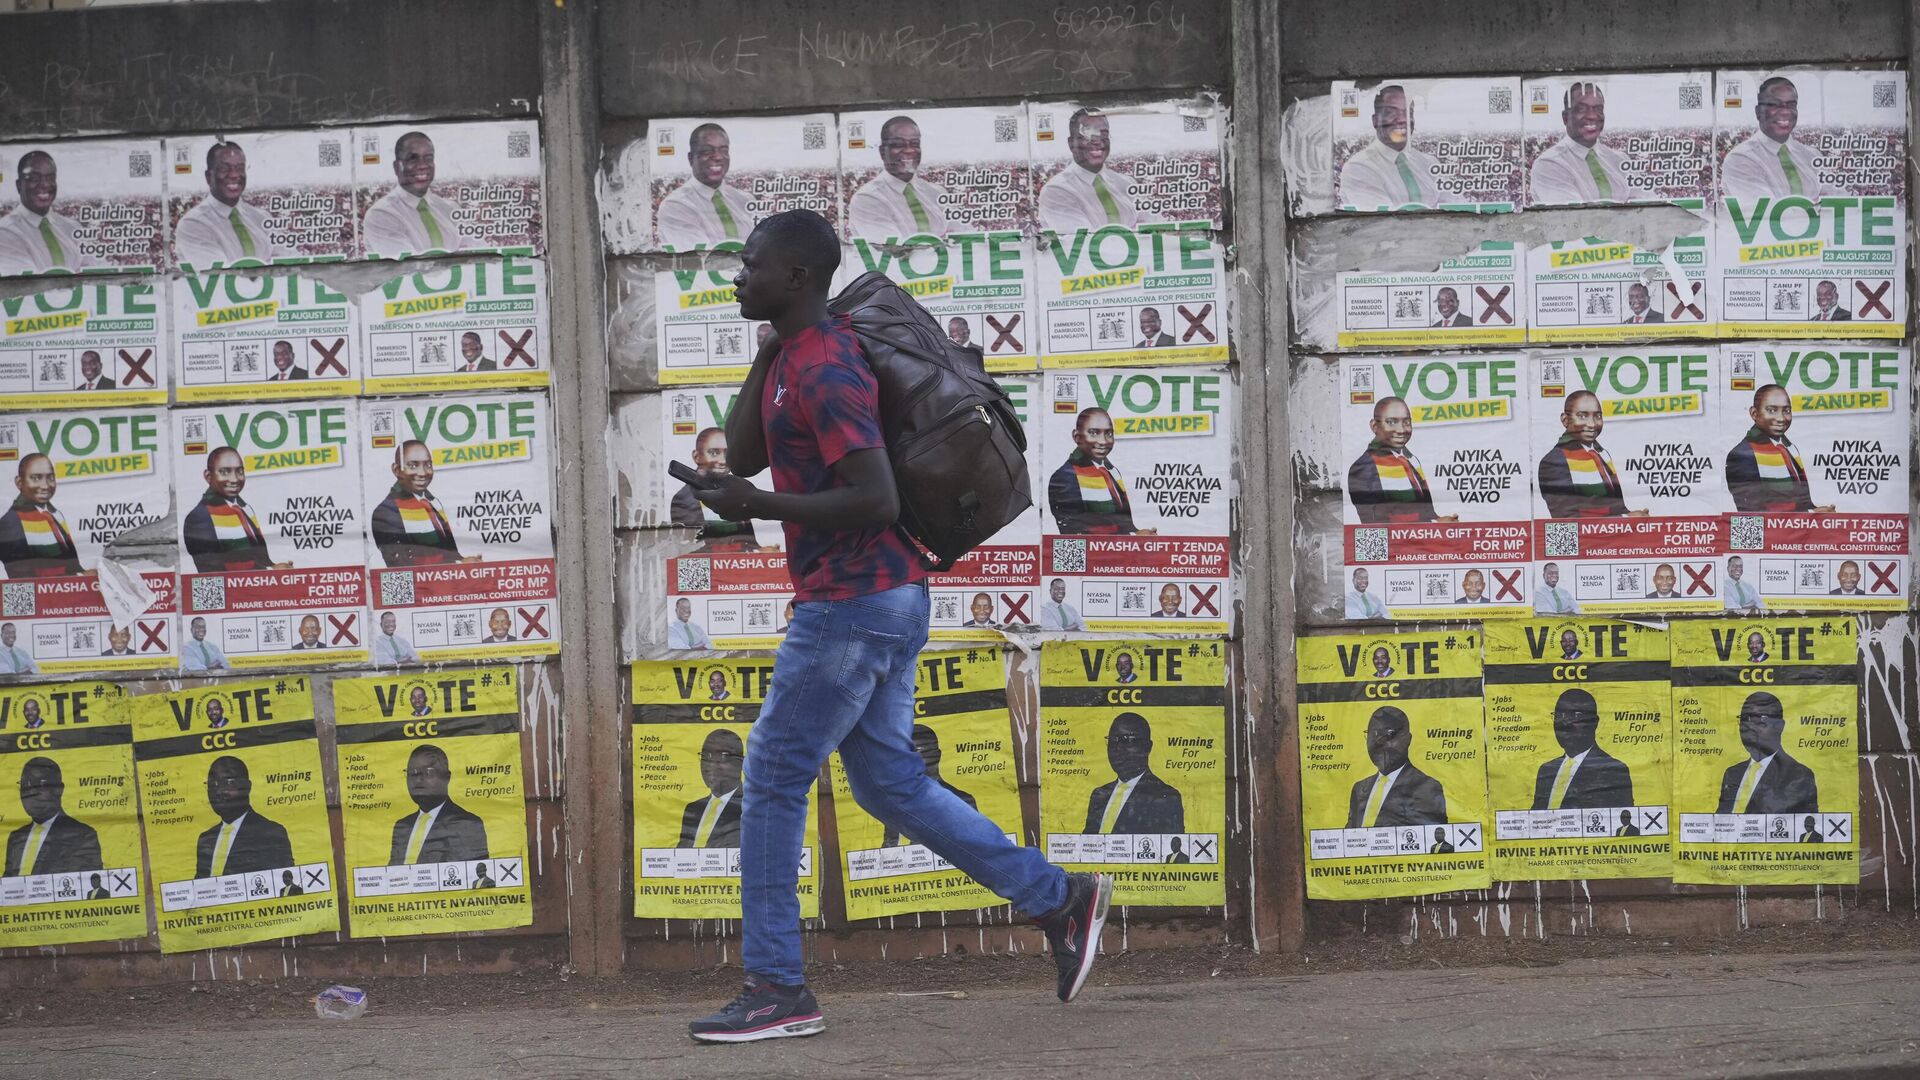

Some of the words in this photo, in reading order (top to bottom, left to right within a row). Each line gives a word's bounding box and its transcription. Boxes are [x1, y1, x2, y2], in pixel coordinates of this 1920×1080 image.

[1438, 142, 1503, 158] Building
[1629, 137, 1694, 154] Building
[1821, 136, 1886, 150] Building
[1430, 163, 1456, 175] our
[1461, 160, 1511, 174] nation
[1621, 160, 1647, 171] our
[1652, 156, 1702, 170] nation
[1813, 157, 1839, 167] our
[1844, 154, 1894, 167] nation
[1135, 160, 1200, 178] Building
[754, 177, 818, 194] Building
[945, 170, 1010, 187] Building
[1437, 178, 1507, 194] together
[1627, 174, 1698, 190] together
[1819, 173, 1889, 187] together
[1128, 183, 1154, 195] our
[1158, 178, 1209, 194] nation
[459, 186, 523, 203] Building
[938, 193, 964, 205] our
[968, 188, 1019, 203] nation
[270, 194, 334, 212] Building
[746, 200, 772, 212] our
[777, 196, 827, 210] nation
[1135, 196, 1205, 214] together
[80, 205, 144, 222] Building
[452, 208, 477, 220] our
[482, 204, 531, 219] nation
[945, 207, 1015, 224] together
[263, 217, 289, 229] our
[293, 212, 343, 228] nation
[1725, 197, 1895, 245] VOTE
[73, 228, 99, 239] our
[103, 224, 152, 238] nation
[458, 222, 527, 239] together
[270, 231, 339, 248] together
[80, 242, 148, 258] together
[1043, 221, 1214, 278] VOTE
[1559, 249, 1605, 265] ZANU
[1610, 246, 1628, 259] PF
[1748, 245, 1794, 260] ZANU
[1800, 243, 1818, 255] PF
[1824, 253, 1835, 261] 23
[1836, 253, 1870, 261] AUGUST
[1344, 276, 1389, 285] EMMERSON
[1400, 275, 1456, 284] MNANGAGWA
[1456, 274, 1473, 283] FOR
[1473, 273, 1515, 282] PRESIDENT
[1723, 268, 1769, 276] EMMERSON
[1779, 268, 1835, 276] MNANGAGWA
[1836, 268, 1853, 276] FOR
[1853, 268, 1895, 277] PRESIDENT
[1070, 274, 1116, 292] ZANU
[1120, 271, 1139, 283] PF
[1145, 279, 1156, 288] 23
[1157, 278, 1190, 286] AUGUST
[1191, 276, 1212, 285] 2023
[953, 289, 965, 297] 23
[965, 287, 1000, 296] AUGUST
[1000, 286, 1021, 295] 2023
[205, 307, 250, 324] ZANU
[255, 304, 273, 316] PF
[87, 323, 98, 331] 23
[99, 321, 132, 330] AUGUST
[133, 321, 153, 329] 2023
[370, 323, 413, 331] EMMERSON
[425, 320, 478, 328] MNANGAGWA
[479, 318, 496, 327] FOR
[497, 318, 536, 326] PRESIDENT
[1764, 351, 1898, 390] VOTE
[1087, 374, 1219, 414] VOTE
[214, 407, 347, 453] VOTE
[1124, 419, 1176, 433] ZANU
[1182, 417, 1203, 430] PF
[26, 414, 157, 459] VOTE
[254, 452, 306, 470] ZANU
[310, 449, 331, 464] PF
[1453, 449, 1502, 462] NYIKA
[1435, 462, 1521, 477] INOVAKWA
[1447, 477, 1511, 490] NEVENE
[286, 495, 334, 510] NYIKA
[1459, 491, 1500, 504] VAYO
[96, 502, 144, 516] NYIKA
[268, 508, 354, 524] INOVAKWA
[280, 522, 344, 537] NEVENE
[1582, 523, 1632, 534] NYASHA
[1636, 522, 1662, 533] GIFT
[1666, 523, 1672, 532] T
[1676, 521, 1718, 532] ZENDA
[293, 537, 333, 551] VAYO
[1664, 535, 1691, 545] FOR
[1695, 535, 1715, 544] MP
[994, 551, 1035, 561] ZENDA
[714, 559, 764, 570] NYASHA
[982, 564, 1009, 574] FOR
[1013, 564, 1032, 574] MP
[1093, 566, 1125, 574] HARARE
[1125, 566, 1161, 574] CENTRAL
[1161, 566, 1222, 575] CONSTITUENCY
[416, 570, 466, 582] NYASHA
[470, 568, 496, 579] GIFT
[499, 568, 506, 577] T
[508, 564, 550, 576] ZENDA
[498, 579, 524, 590] FOR
[528, 578, 547, 588] MP
[1739, 668, 1773, 683] CCC
[1107, 689, 1141, 704] CCC
[1365, 683, 1399, 698] CCC
[1614, 711, 1660, 723] Winning
[403, 721, 438, 737] CCC
[1630, 722, 1646, 731] For
[17, 733, 51, 750] CCC
[642, 734, 660, 743] Jobs
[1613, 733, 1663, 745] Everyone!
[644, 743, 662, 752] Food
[955, 739, 1002, 755] Winning
[644, 753, 669, 762] Health
[971, 752, 988, 762] For
[644, 763, 678, 771] Freedom
[956, 761, 1006, 777] Everyone!
[266, 769, 312, 786] Winning
[644, 773, 667, 781] Peace
[282, 782, 298, 793] For
[644, 783, 684, 792] Prosperity
[267, 791, 316, 808] Everyone!
[1679, 851, 1719, 860] IRVINE
[1722, 851, 1772, 860] HATITYE
[1776, 851, 1852, 860] NYANINGWE
[1310, 866, 1351, 876] IRVINE
[1354, 864, 1404, 875] HATITYE
[1407, 860, 1483, 872] NYANINGWE
[1710, 864, 1738, 872] HARARE
[1739, 864, 1769, 872] CENTRAL
[1769, 864, 1821, 872] CONSTITUENCY
[354, 903, 394, 914] IRVINE
[397, 899, 446, 911] HATITYE
[450, 894, 525, 908] NYANINGWE
